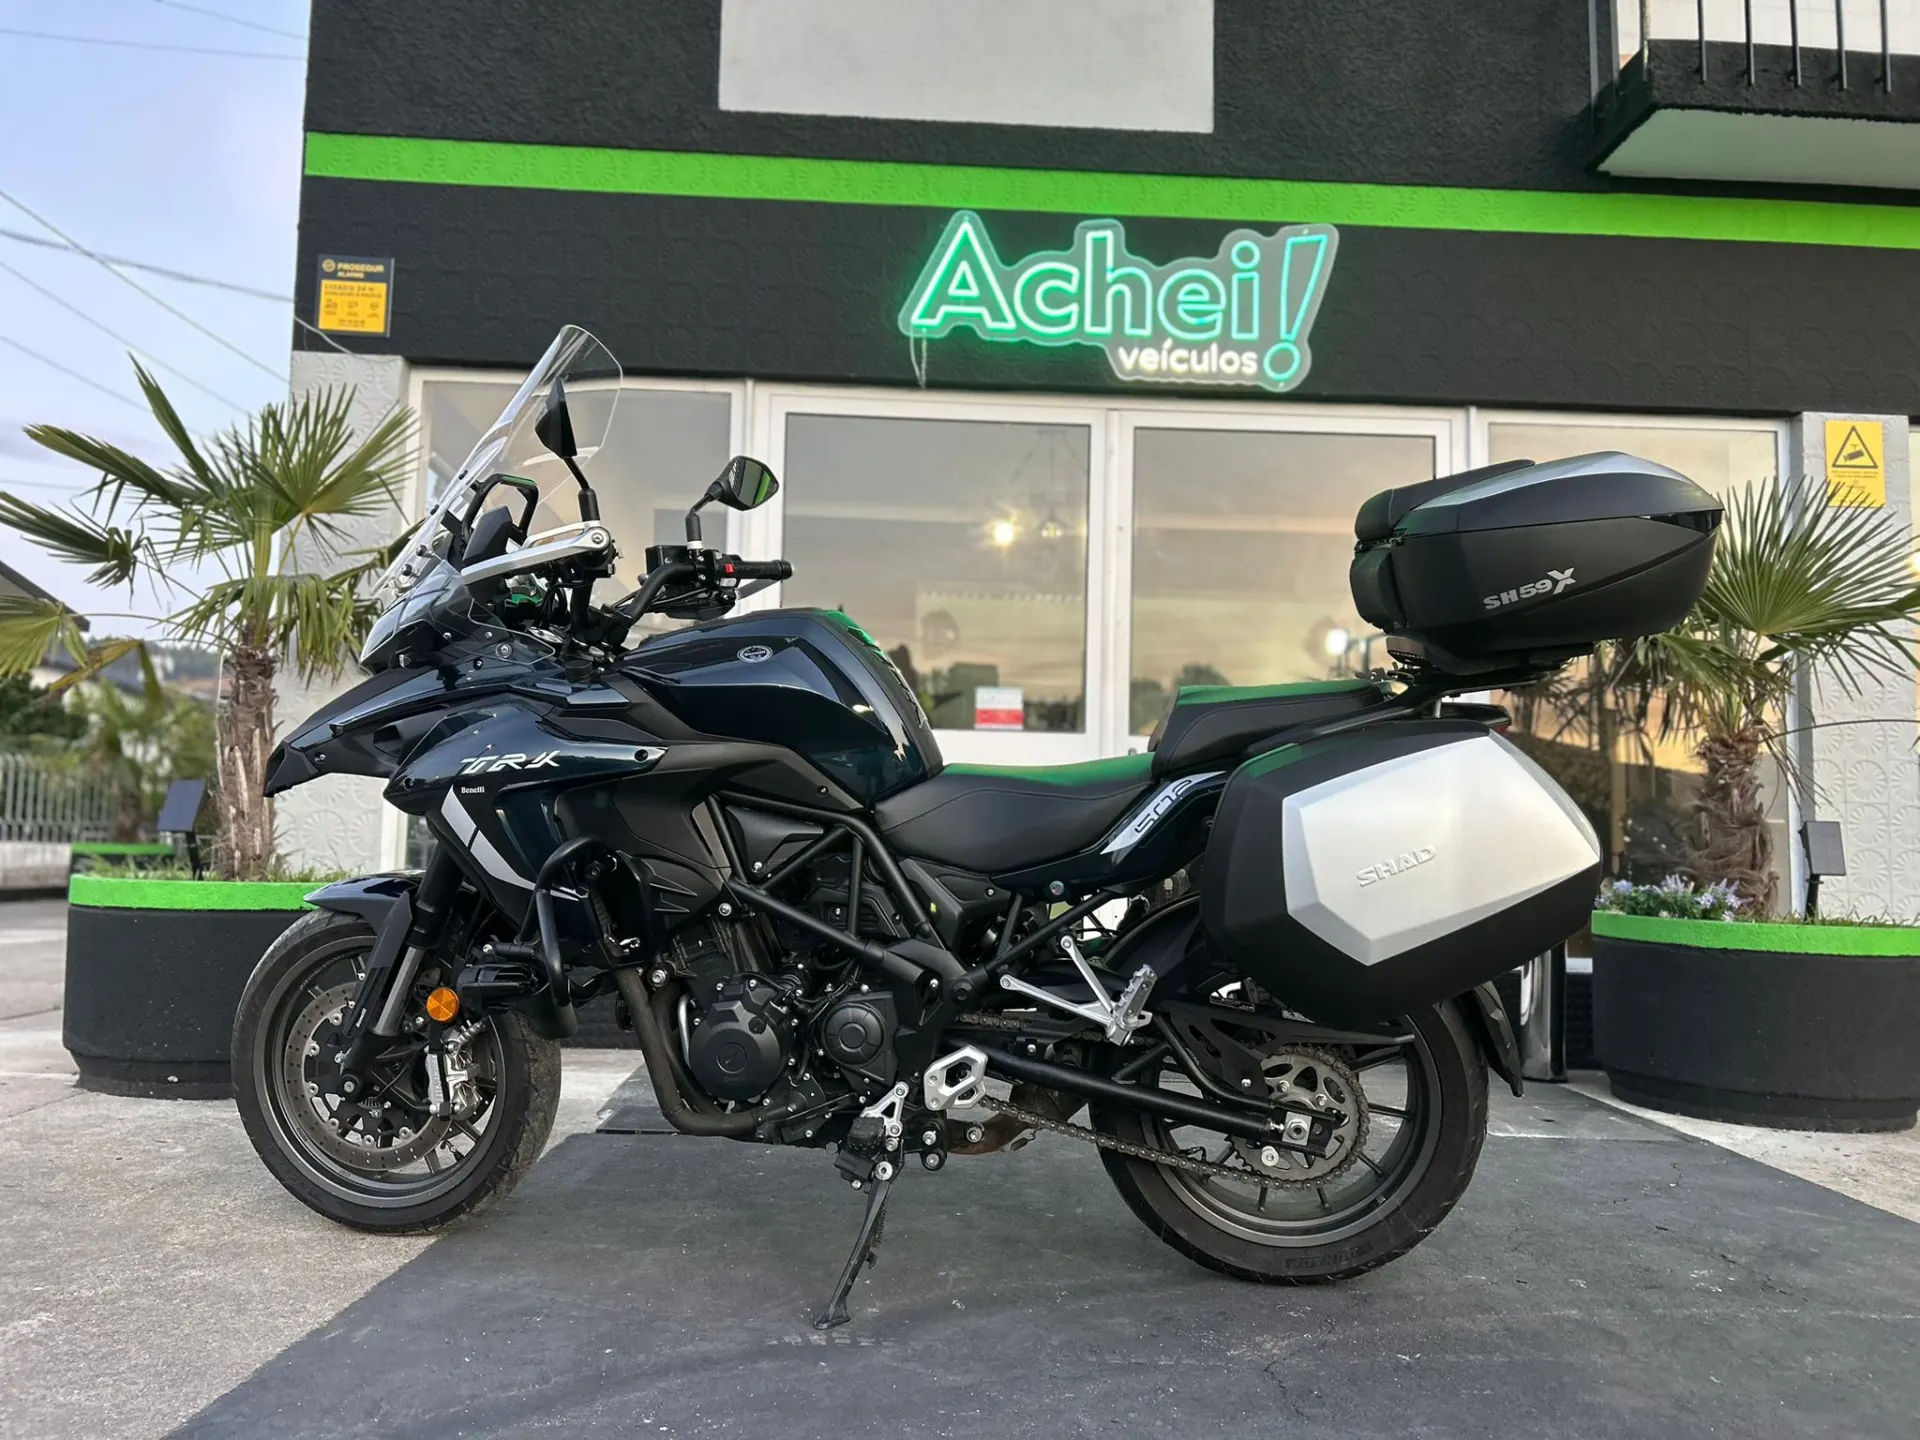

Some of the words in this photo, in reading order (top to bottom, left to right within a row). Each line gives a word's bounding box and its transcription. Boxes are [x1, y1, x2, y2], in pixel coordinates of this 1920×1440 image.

[911, 219, 1329, 381] Achei!
[1118, 338, 1258, 375] veículos
[460, 750, 560, 775] TRK
[461, 785, 485, 794] Benelli
[1356, 844, 1436, 887] SHAD
